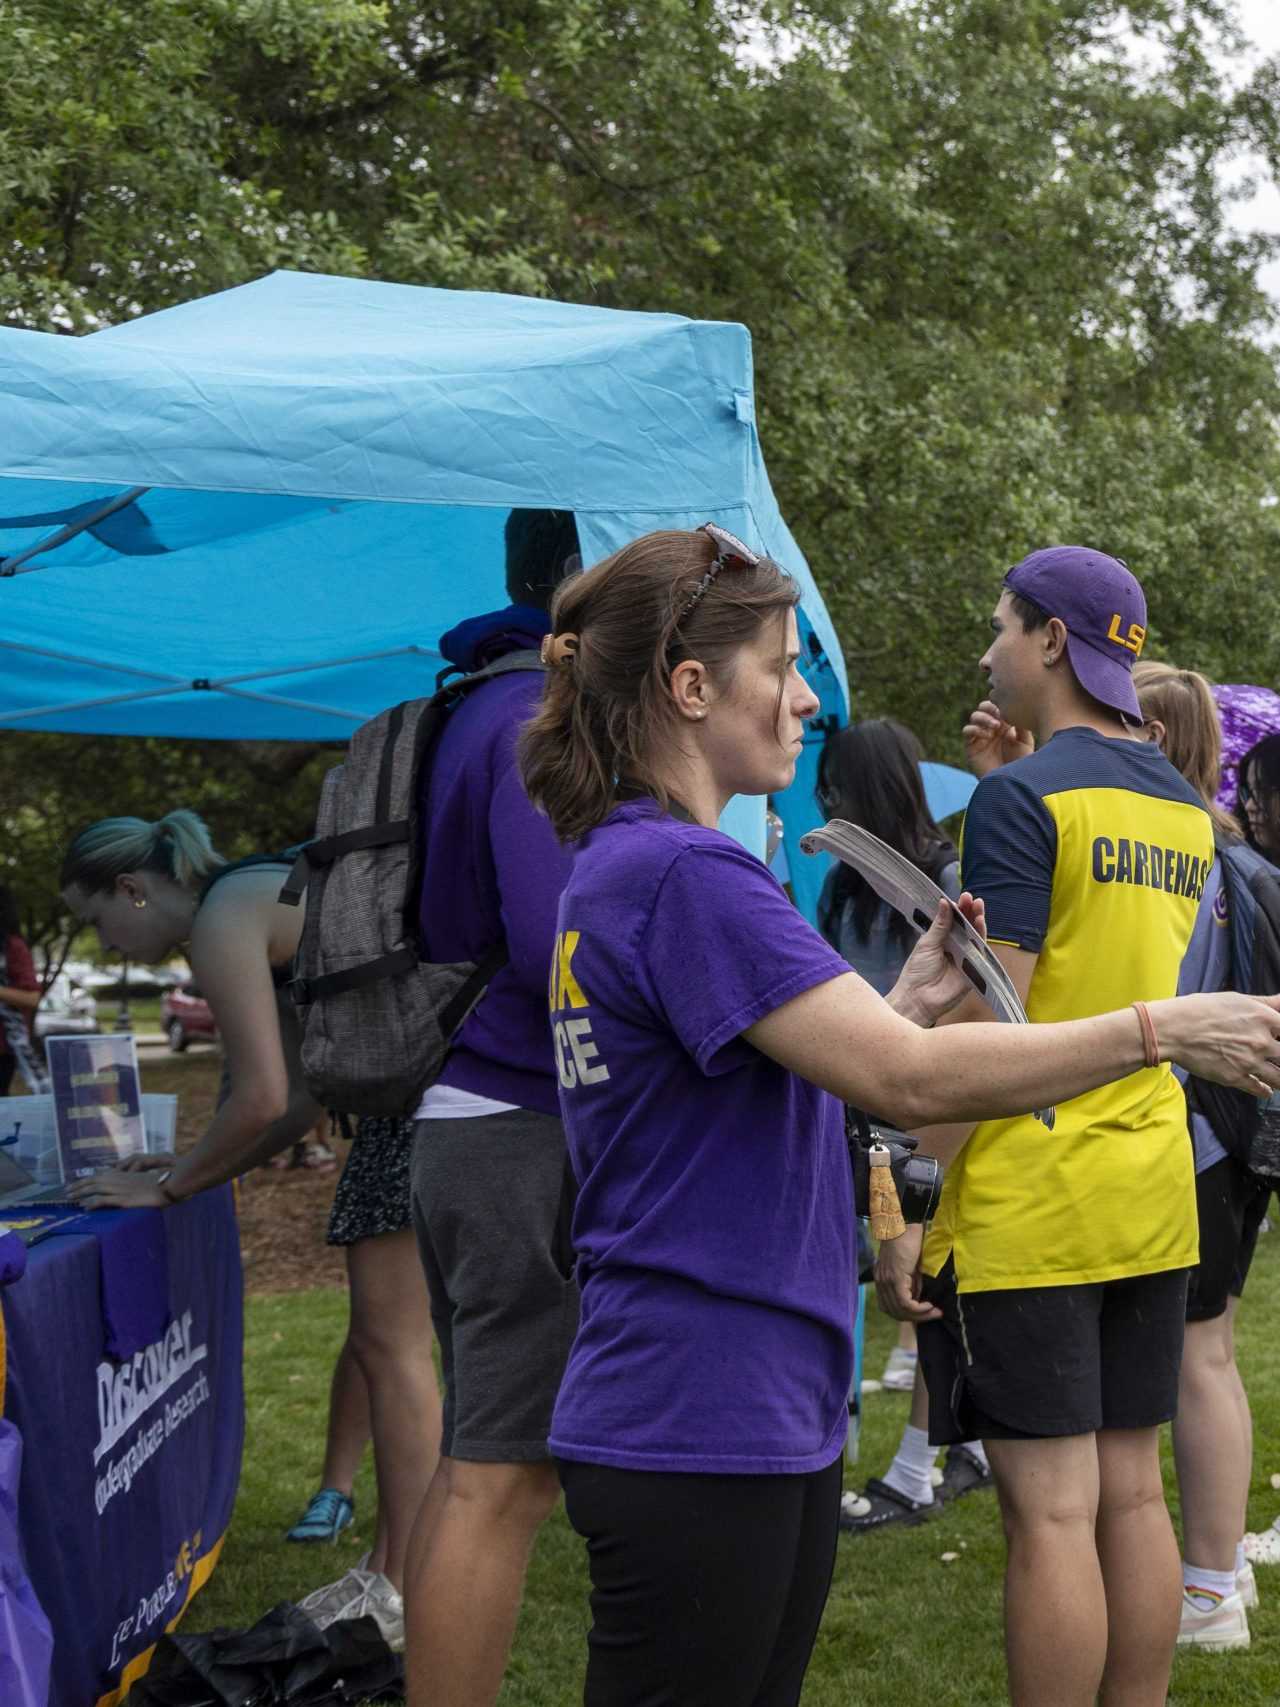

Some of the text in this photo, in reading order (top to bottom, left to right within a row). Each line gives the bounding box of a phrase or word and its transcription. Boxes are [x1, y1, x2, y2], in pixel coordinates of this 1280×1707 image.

[1107, 613, 1146, 658] LS
[1092, 836, 1208, 902] CARDENAS
[94, 1309, 208, 1467] Discover
